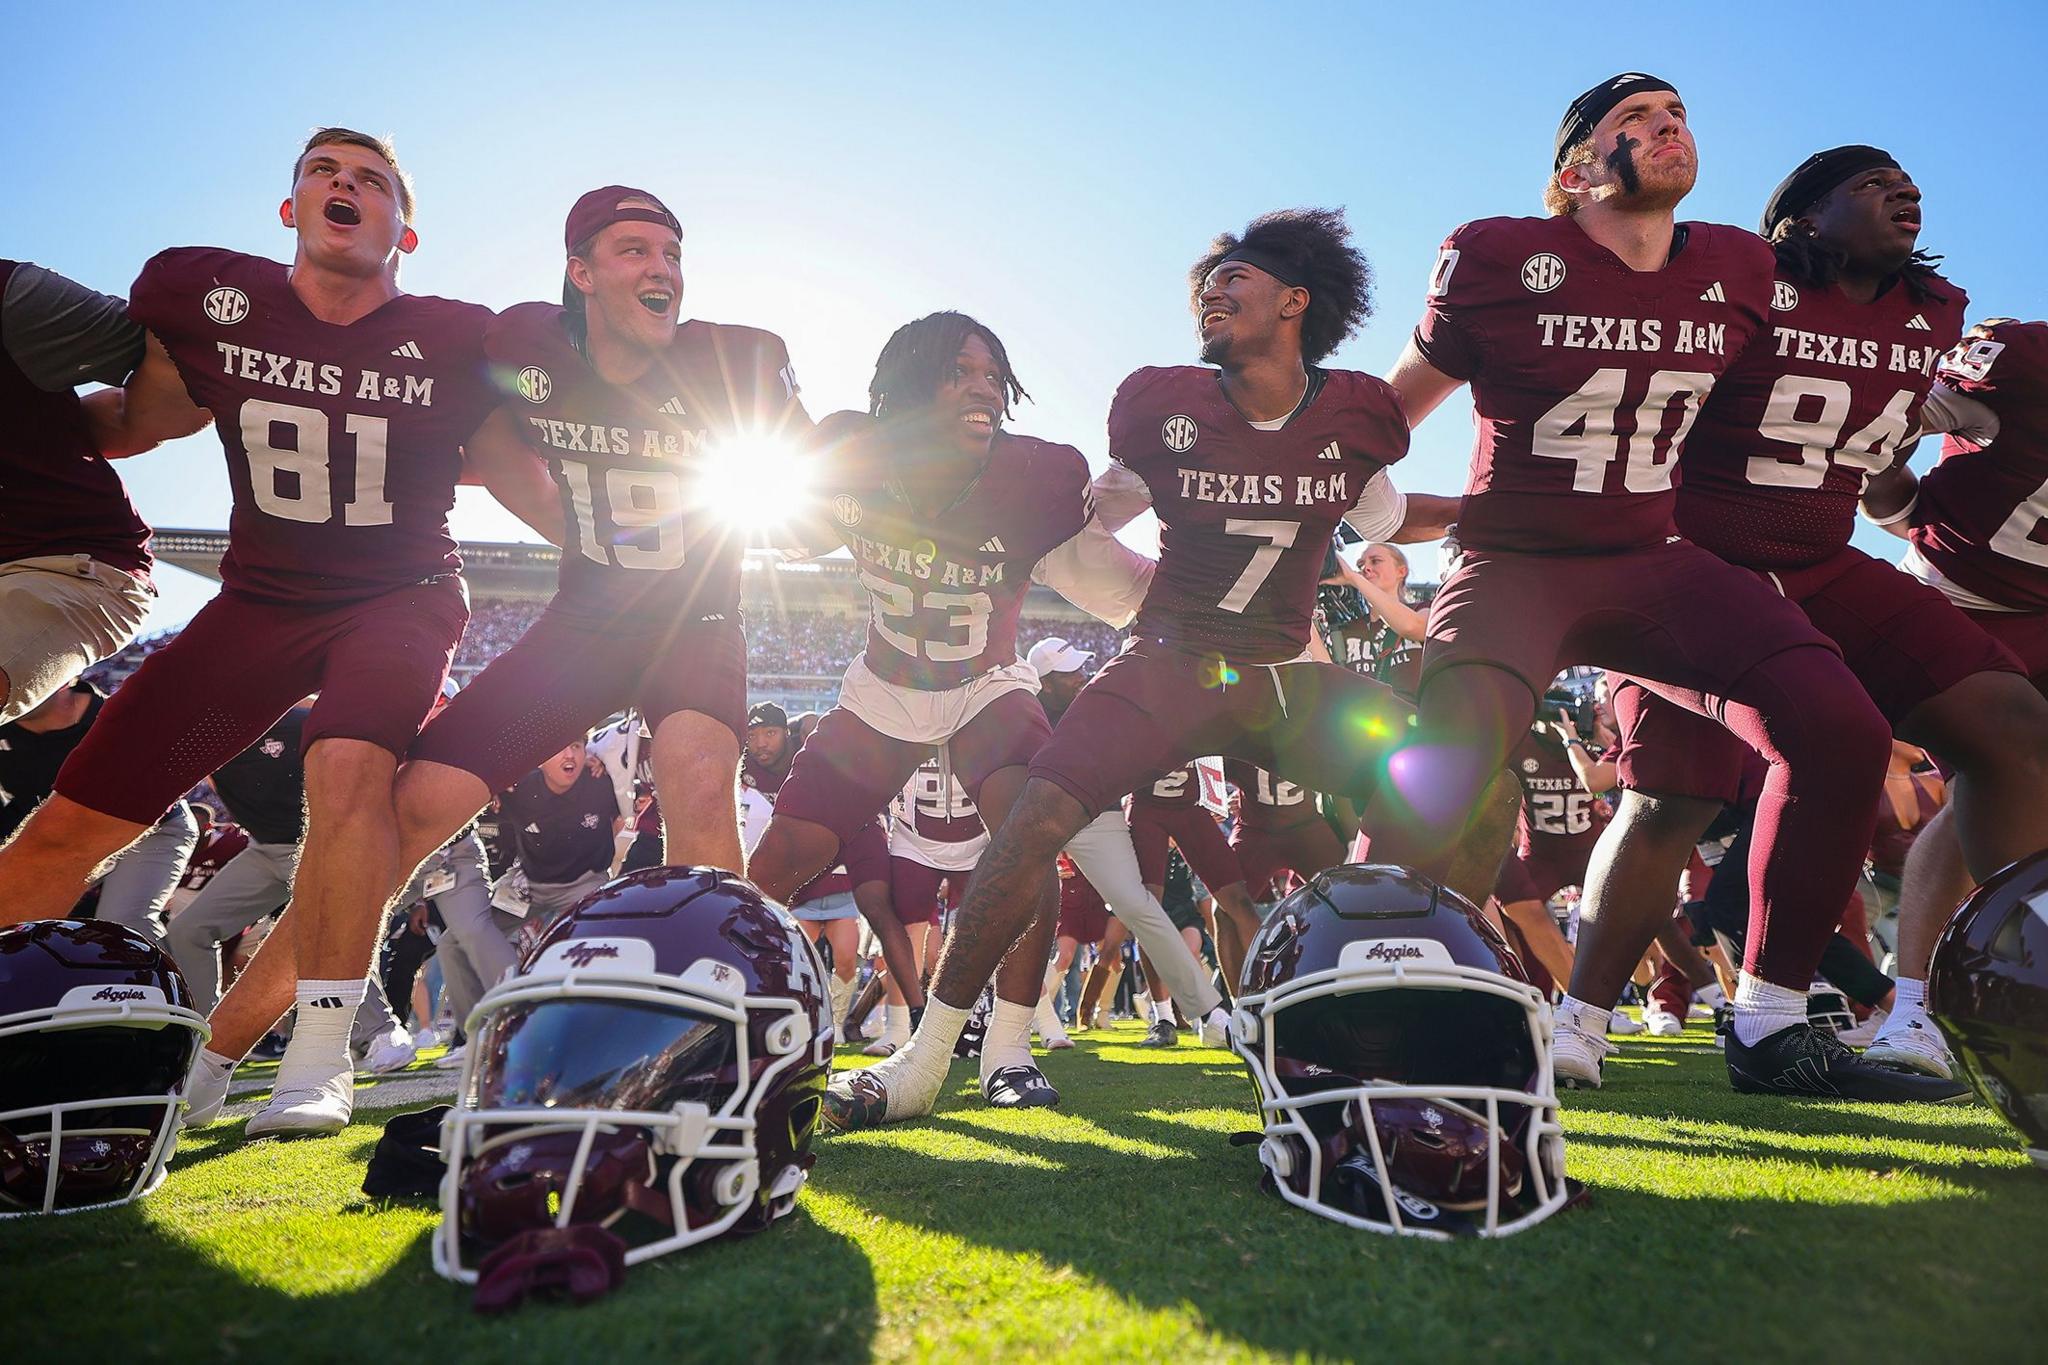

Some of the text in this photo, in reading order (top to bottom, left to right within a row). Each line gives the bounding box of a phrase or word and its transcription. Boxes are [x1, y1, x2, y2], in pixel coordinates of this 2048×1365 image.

[1523, 255, 1564, 291] SEC
[207, 289, 246, 321] SEC
[1771, 282, 1796, 309] EC
[1536, 314, 1726, 355] TEXAS A&M
[1773, 326, 1879, 369] TEXAS
[217, 342, 434, 406] TEXAS A&M
[520, 368, 550, 402] SEC
[530, 417, 707, 457] TEXAS A&M
[1165, 417, 1196, 450] SEC
[1531, 368, 1716, 494] 40
[1745, 374, 1916, 489] 94
[240, 399, 393, 526] 81
[1178, 468, 1347, 505] TEXAS A&M
[560, 459, 685, 570] 19
[848, 531, 1005, 587] TEXAS A&M
[1217, 518, 1301, 614] 7
[859, 568, 993, 661] 23
[1526, 778, 1572, 791] TEXAS
[1366, 942, 1424, 963] Aggies
[92, 986, 146, 1003] Aggies
